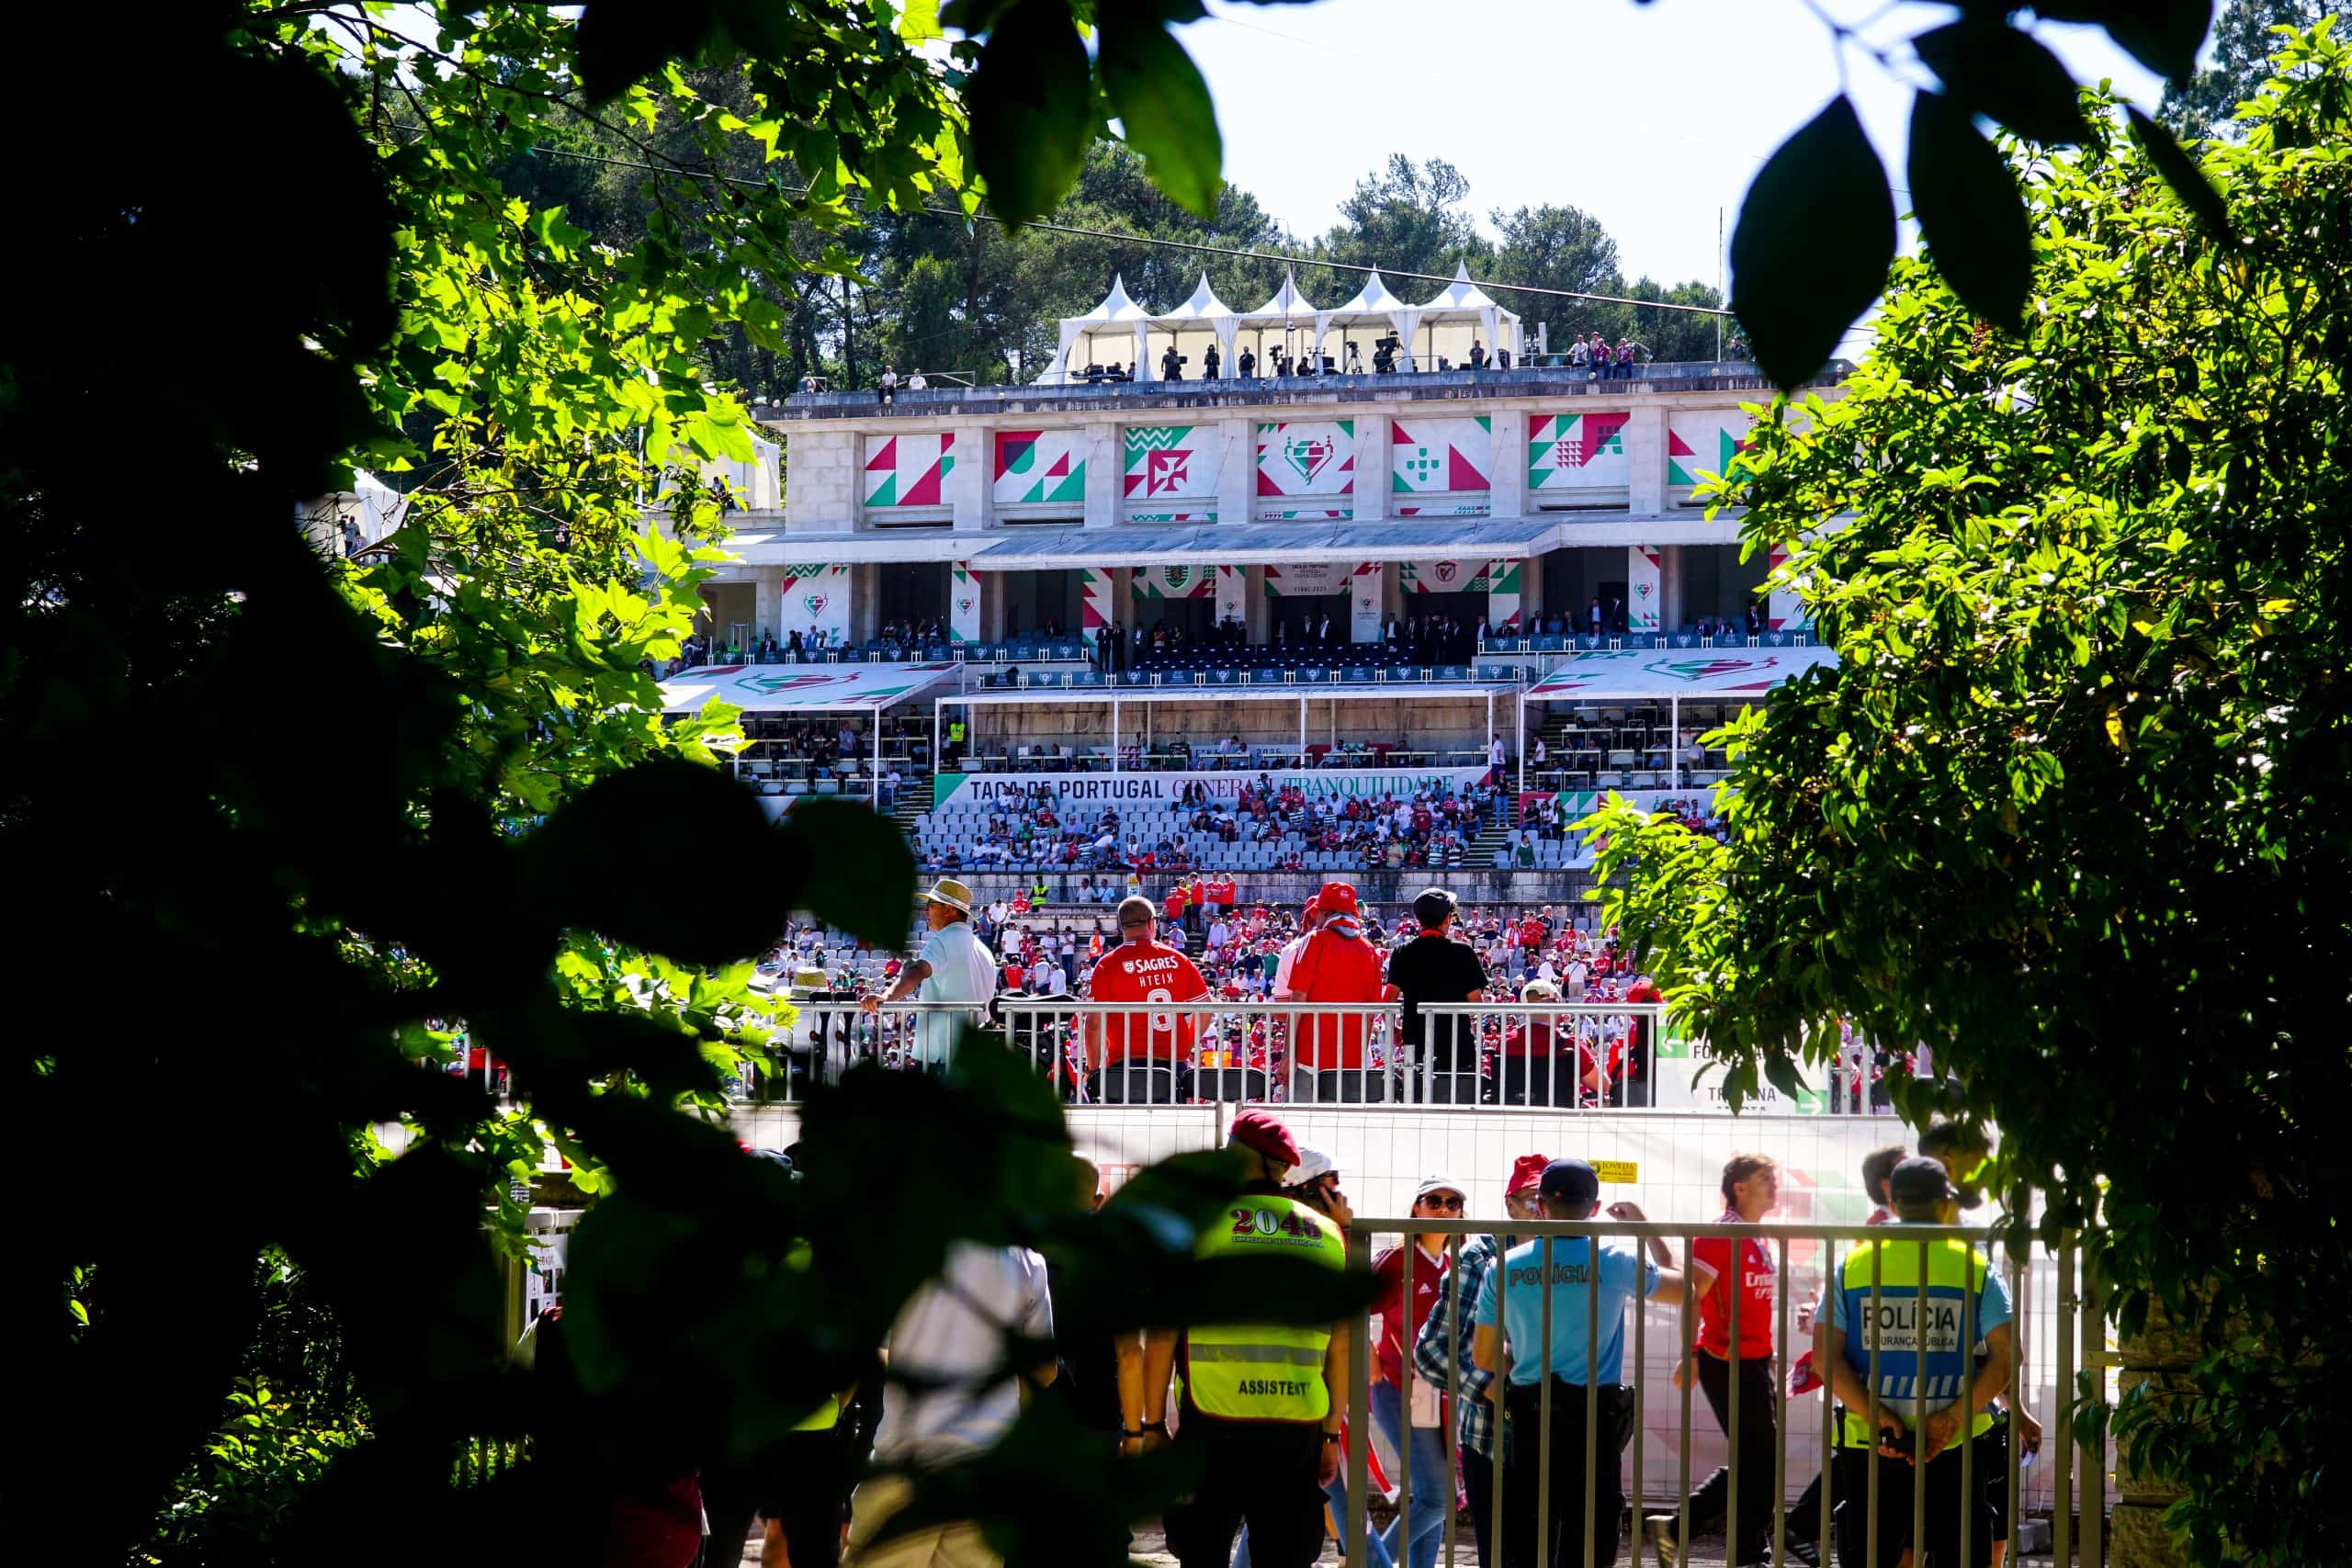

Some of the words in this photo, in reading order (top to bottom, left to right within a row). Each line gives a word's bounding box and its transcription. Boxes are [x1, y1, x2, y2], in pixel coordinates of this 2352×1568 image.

[1059, 780, 1163, 799] PORTUGAL
[1171, 777, 1275, 797] GNERAI
[1136, 955, 1179, 974] SAGRES
[1862, 1301, 1955, 1331] POLÍCIA
[1864, 1336, 1917, 1348] SURANÇA
